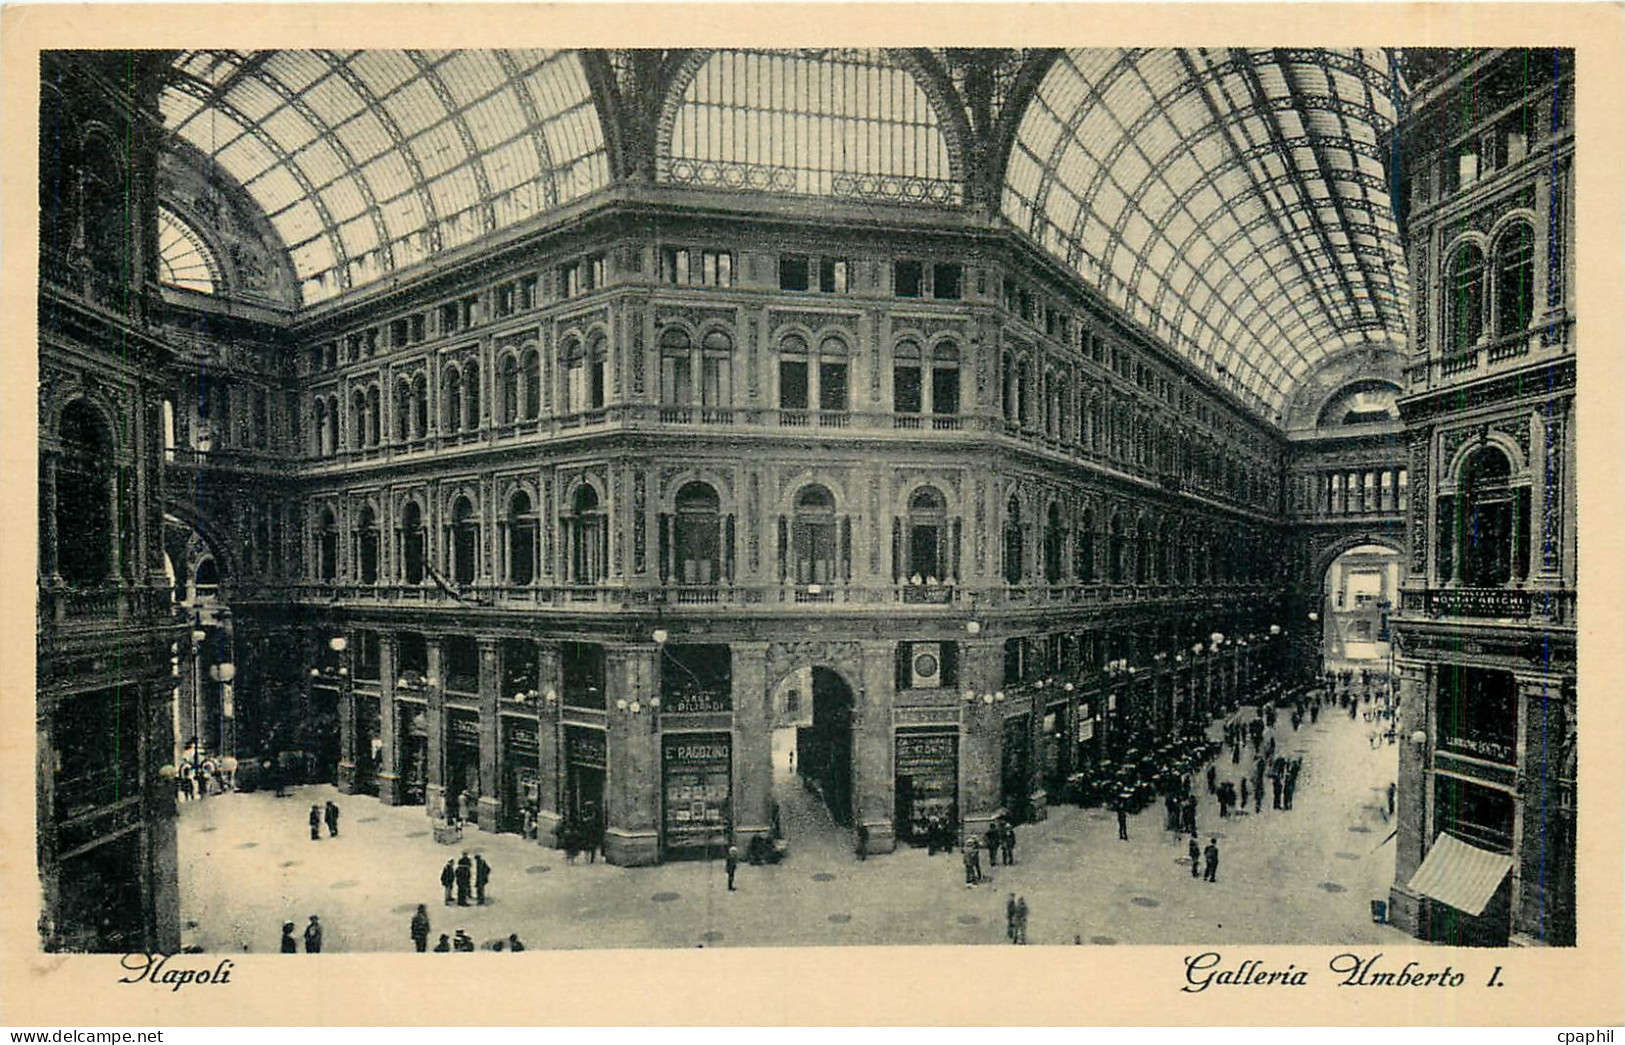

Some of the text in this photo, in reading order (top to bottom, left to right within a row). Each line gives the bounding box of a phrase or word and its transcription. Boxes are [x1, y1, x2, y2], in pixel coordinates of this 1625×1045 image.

[118, 953, 235, 992] Napoli
[1181, 953, 1308, 992] Galleria
[1330, 953, 1465, 987] Umberto
